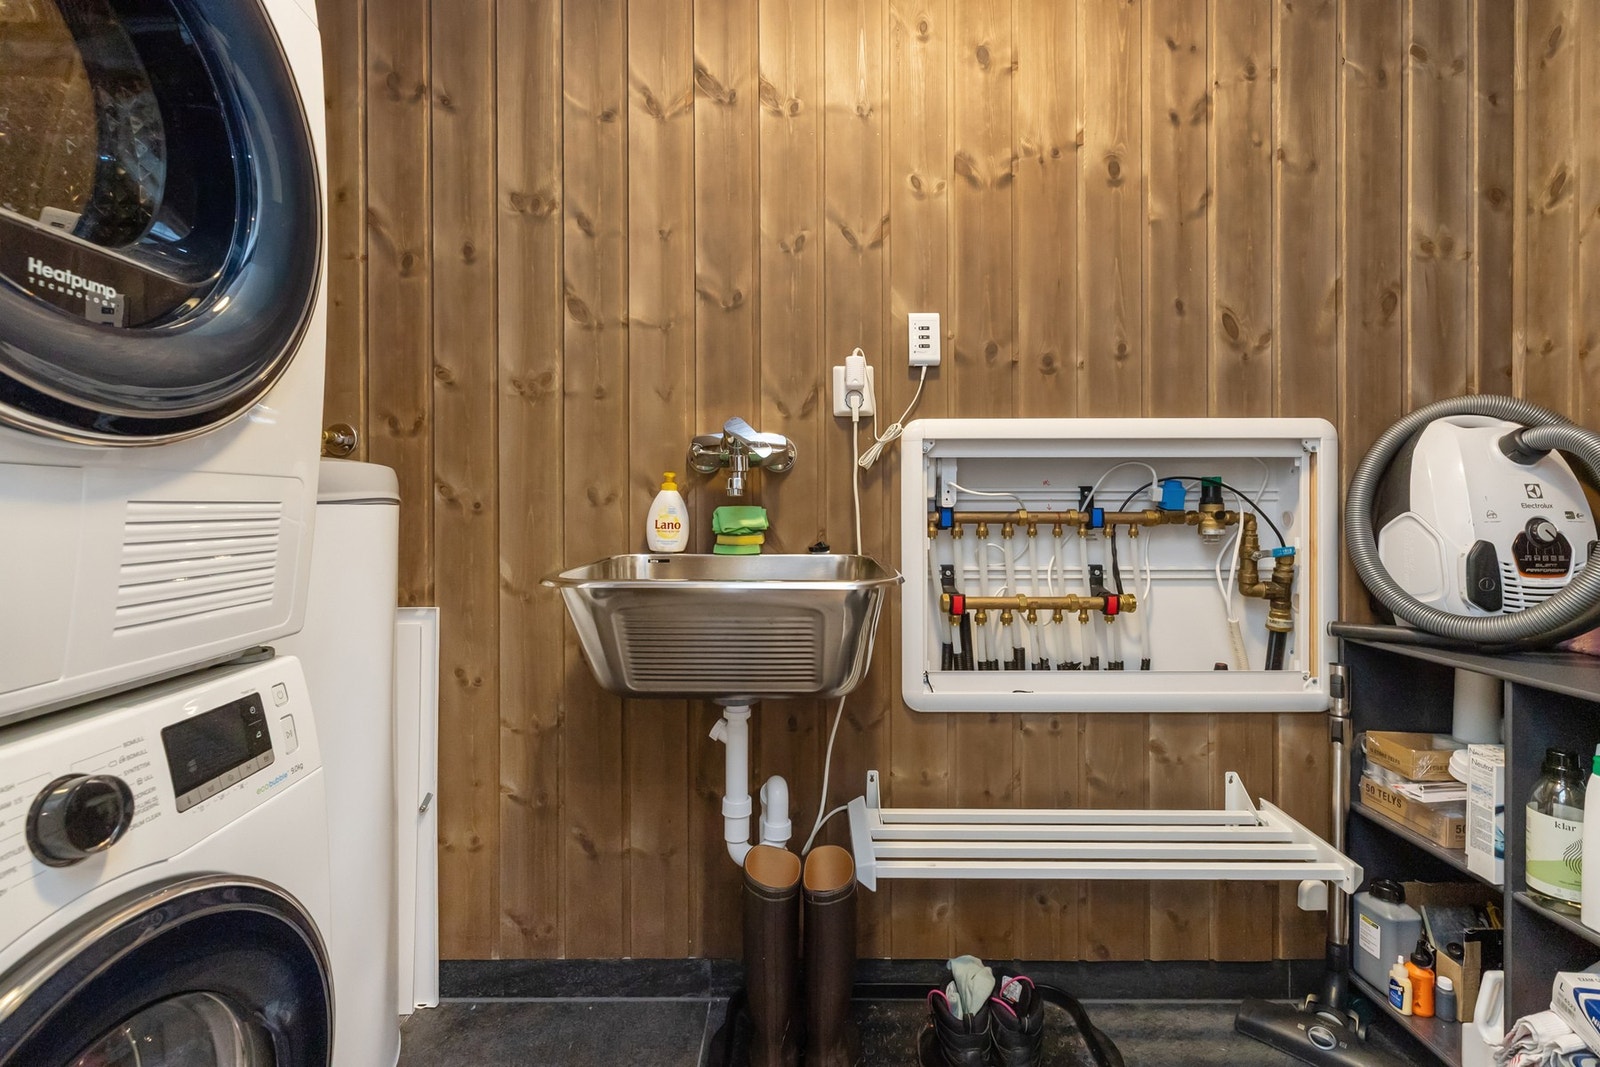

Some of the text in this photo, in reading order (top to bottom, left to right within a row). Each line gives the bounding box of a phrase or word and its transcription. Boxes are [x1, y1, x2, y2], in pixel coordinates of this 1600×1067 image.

[28, 257, 117, 299] Heatpump
[29, 276, 116, 308] TECHNOLOGY
[655, 519, 681, 530] Lano
[1472, 758, 1493, 772] Neutral
[1365, 783, 1402, 809] 50 TELYS
[1554, 821, 1577, 832] klar
